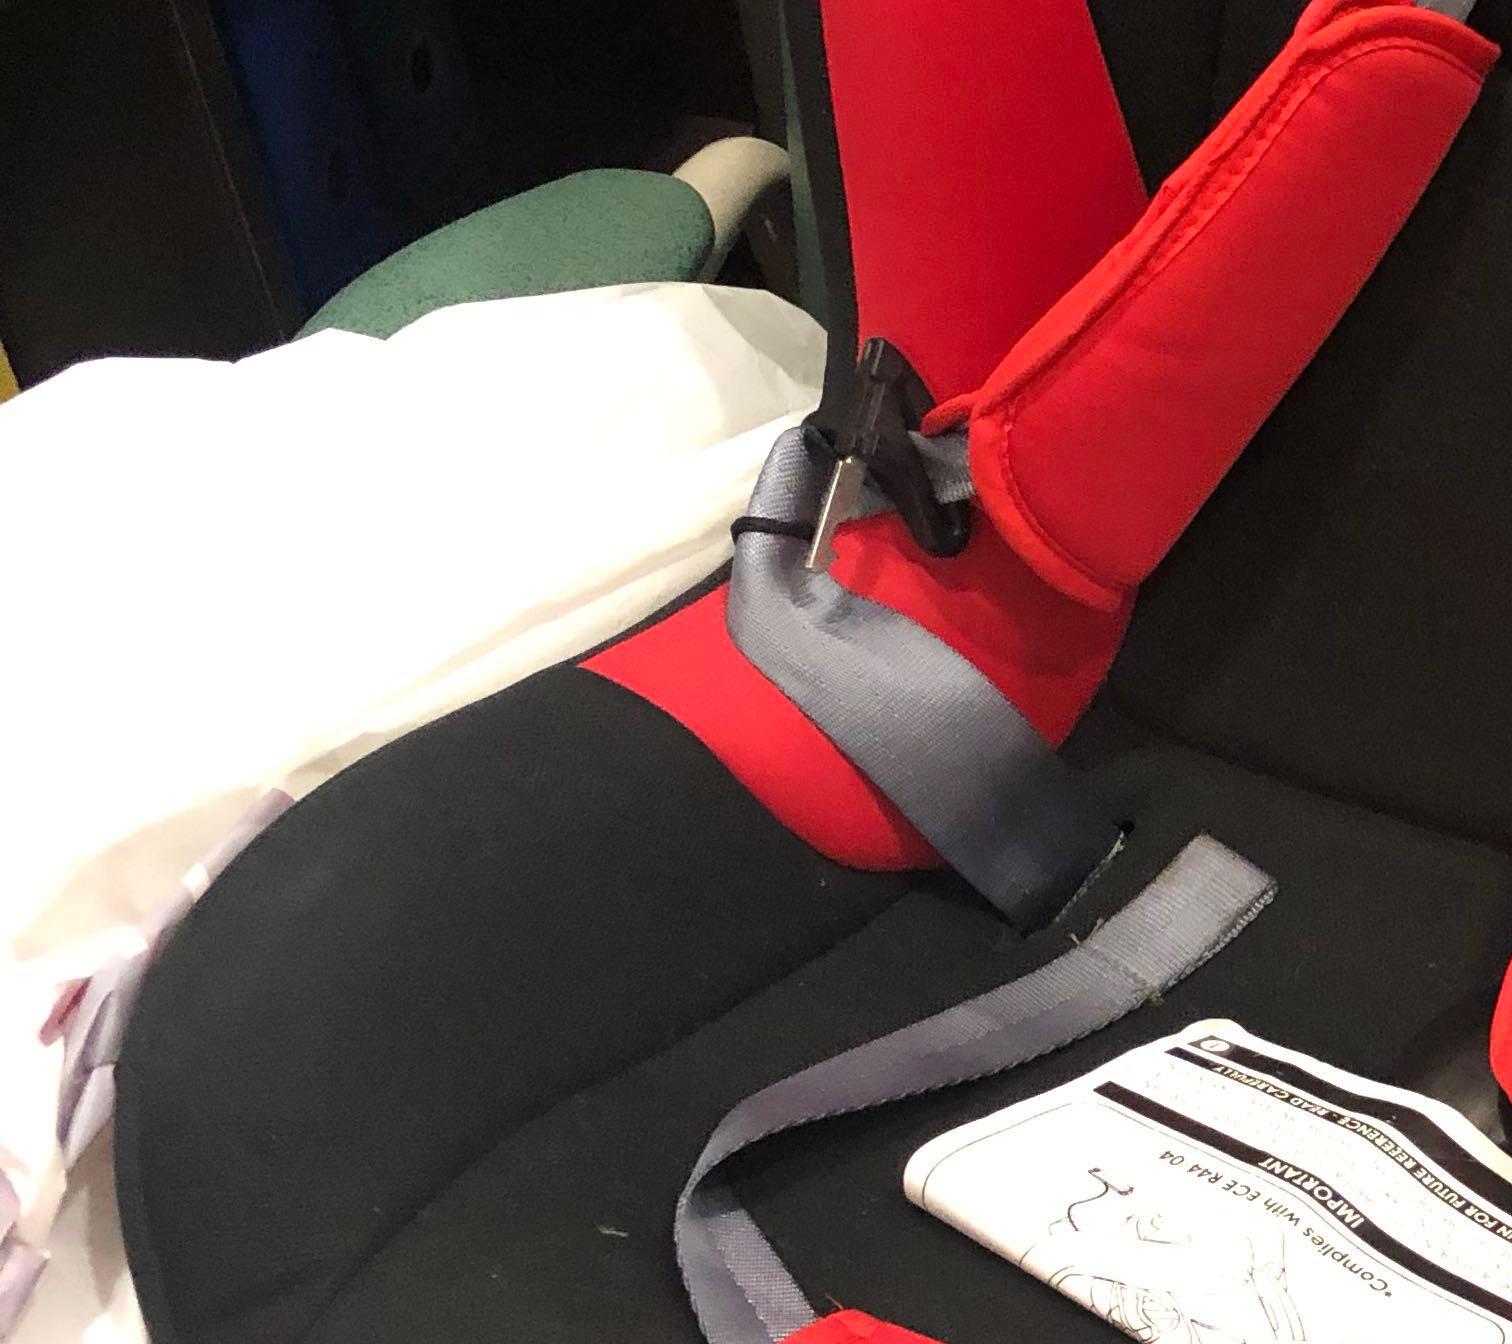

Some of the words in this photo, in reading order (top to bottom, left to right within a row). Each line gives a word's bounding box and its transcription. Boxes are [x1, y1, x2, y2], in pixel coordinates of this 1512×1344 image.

[1211, 1065, 1290, 1099] CAREFULLY
[1159, 1150, 1184, 1166] 04
[1187, 1163, 1223, 1184] R44
[1222, 1179, 1260, 1201] ECE
[1258, 1157, 1365, 1228] IMPORTANT
[1414, 1168, 1466, 1208] FUTURE
[1264, 1197, 1300, 1226] with
[1464, 1205, 1497, 1227] FOR
